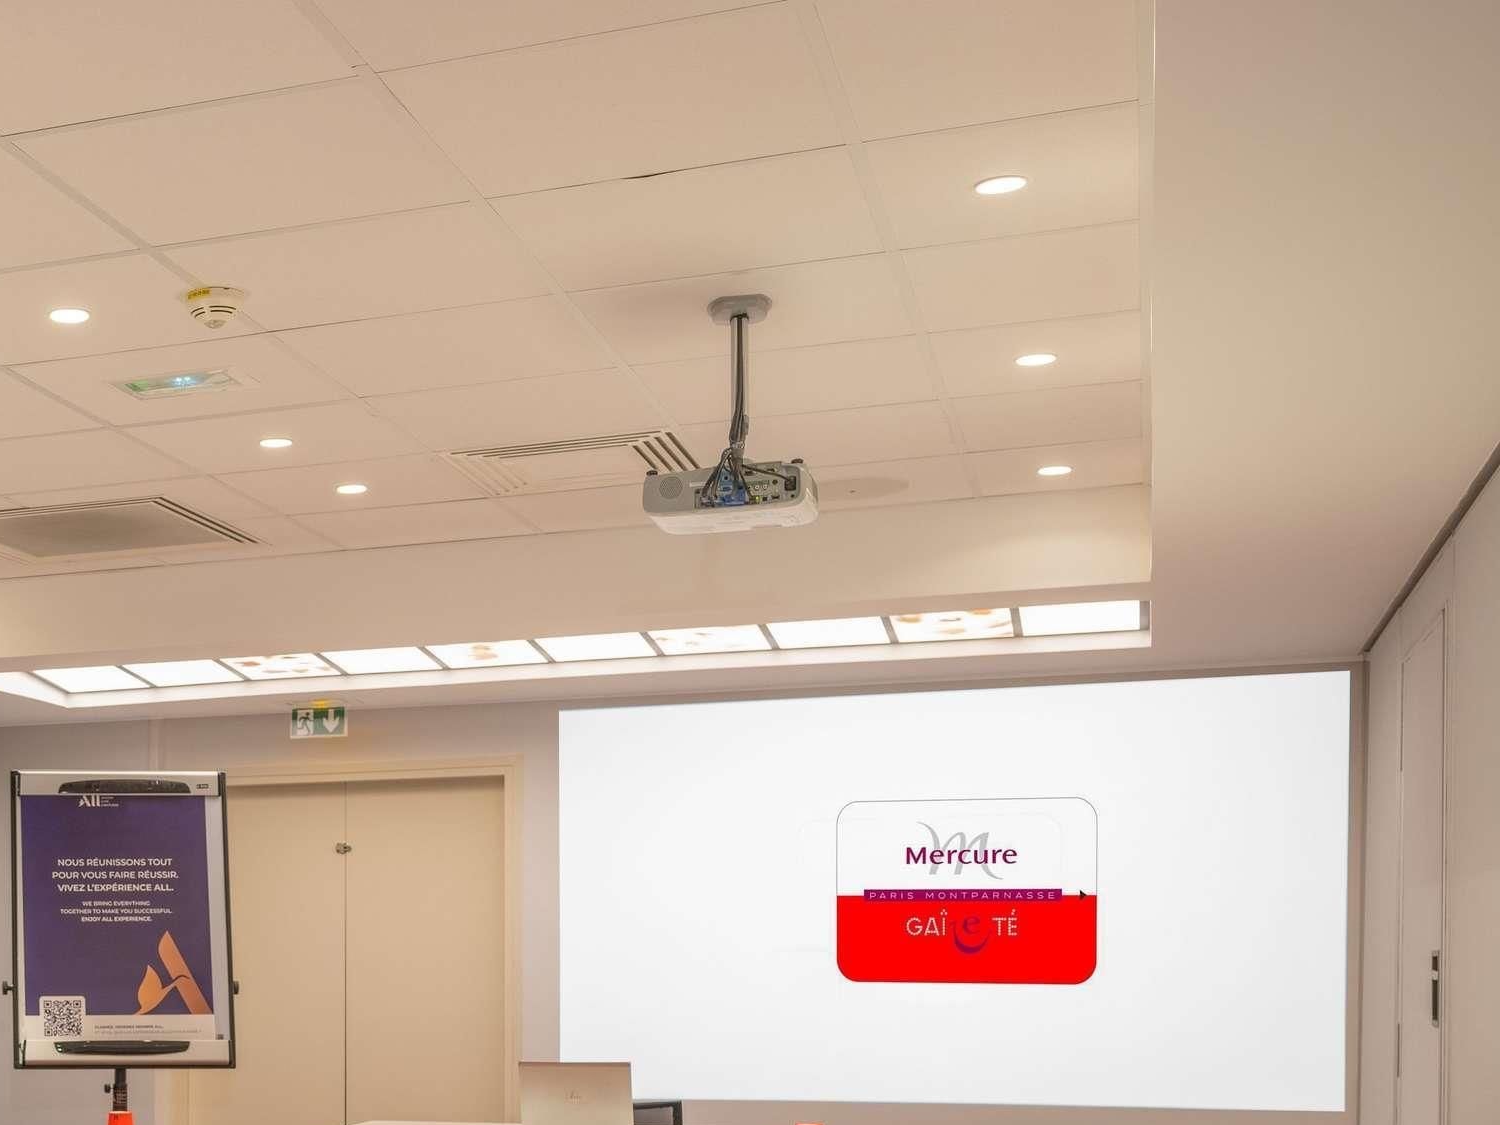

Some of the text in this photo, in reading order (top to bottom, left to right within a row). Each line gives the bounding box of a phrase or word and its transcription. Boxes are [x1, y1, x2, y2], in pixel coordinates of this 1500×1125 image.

[906, 846, 1018, 864] Mercure
[57, 857, 172, 867] NOUS RÉUNISSONS TOUT
[52, 869, 179, 879] POUR VOUS FAIRE RÉUSSIR.
[57, 884, 85, 892] VIVEZ
[925, 891, 1055, 899] MONTPARNASSE
